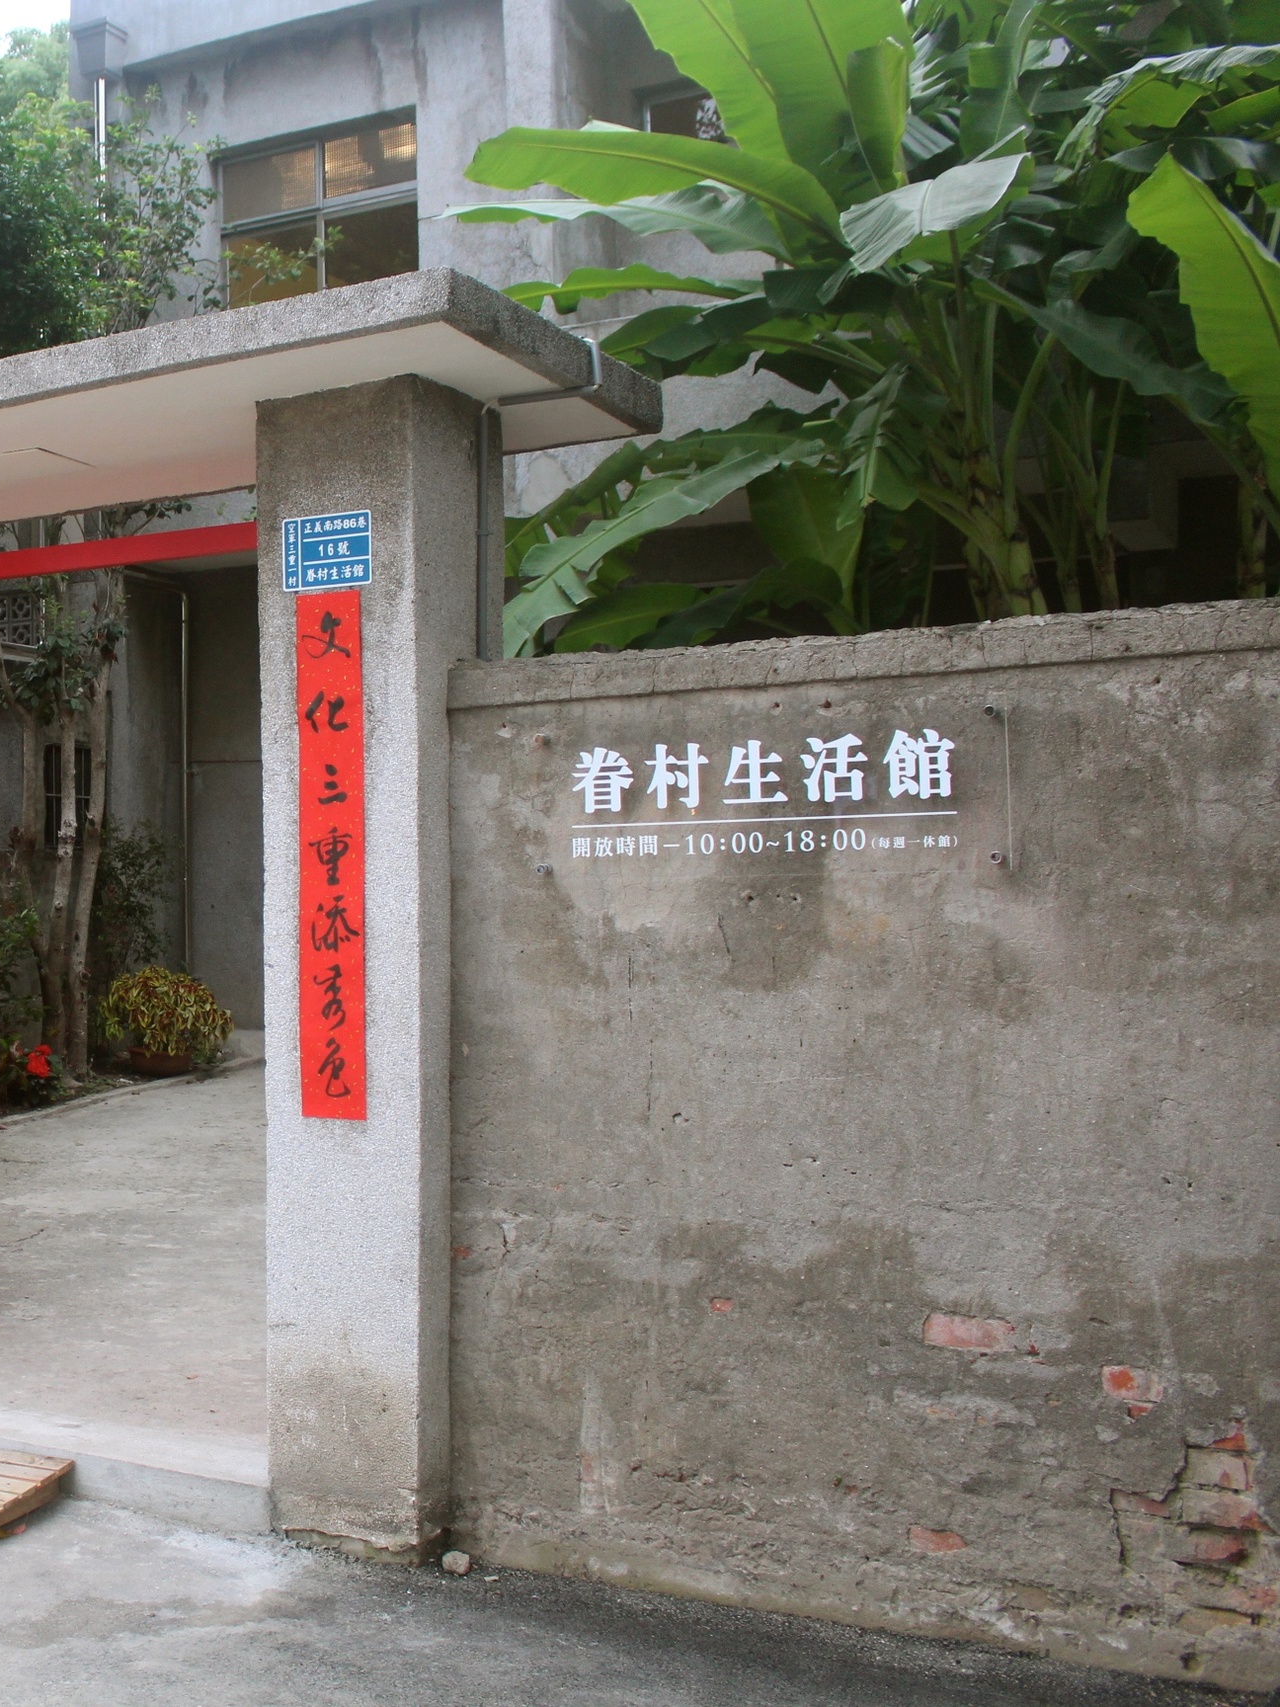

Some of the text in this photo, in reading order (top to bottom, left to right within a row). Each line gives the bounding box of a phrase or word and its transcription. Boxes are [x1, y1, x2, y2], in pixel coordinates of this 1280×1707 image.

[304, 516, 367, 534] 正義南路86巷
[287, 523, 297, 586] 空軍三重一村
[318, 541, 351, 557] 16號
[305, 564, 365, 582] 眷村生活館
[571, 728, 956, 814] 眷村生活館
